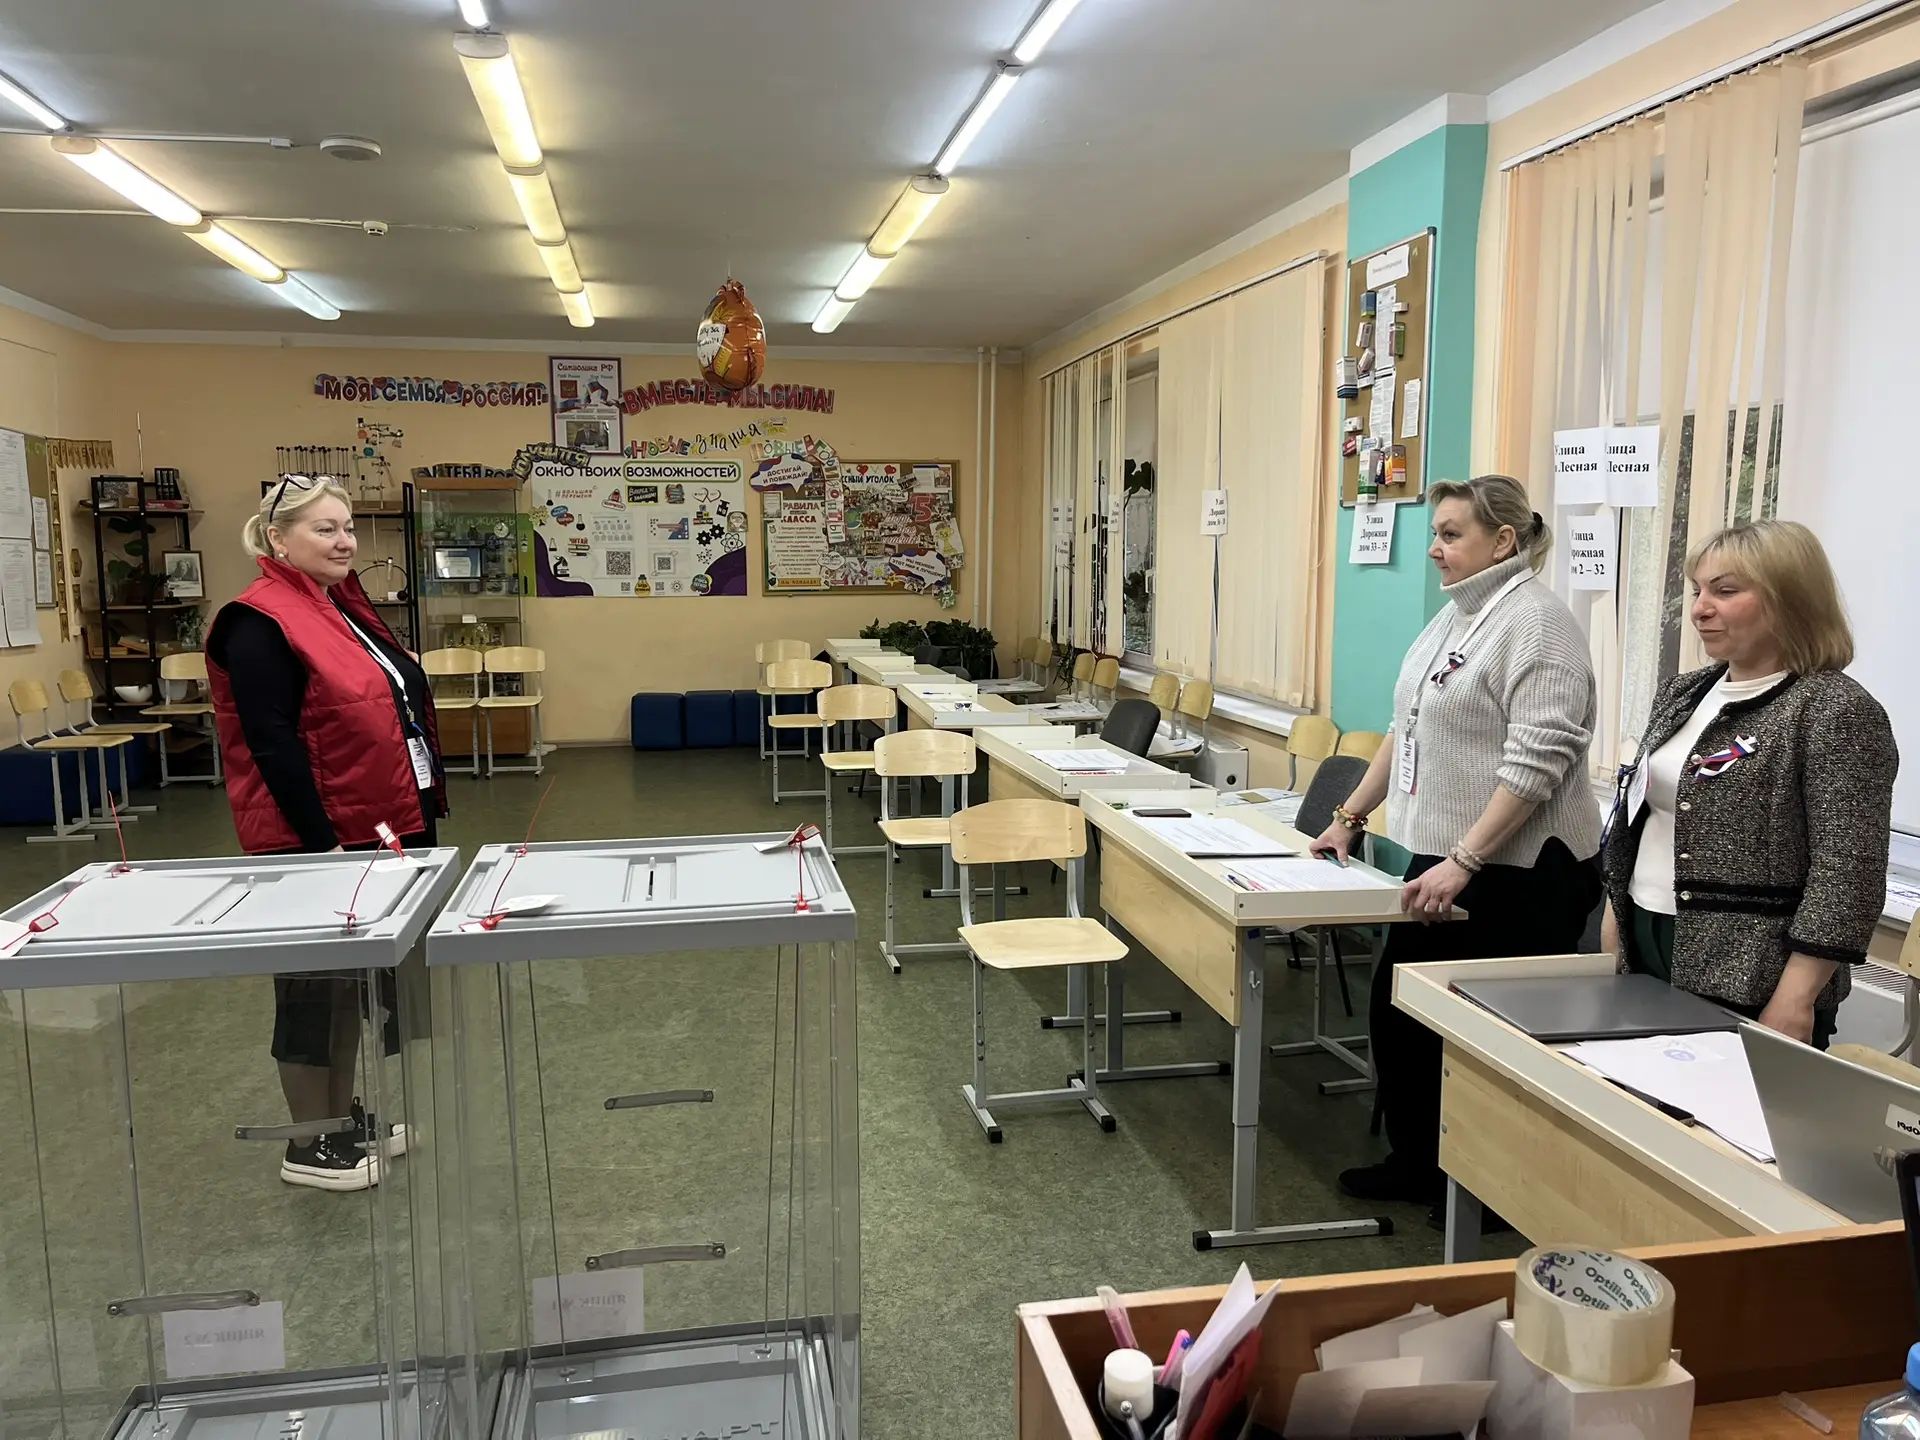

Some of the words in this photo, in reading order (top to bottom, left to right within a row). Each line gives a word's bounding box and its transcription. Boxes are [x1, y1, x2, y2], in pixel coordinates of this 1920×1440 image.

[600, 363, 614, 372] РФ
[324, 379, 372, 401] МОЯ
[382, 382, 446, 403] СЕМЬЯ
[461, 386, 543, 408] РОССИЯ!
[623, 378, 718, 415] ВМЕСТЕ
[727, 383, 766, 408] МЫ
[769, 383, 836, 414] СИЛА!
[630, 434, 692, 459] НОВЫЕ
[534, 466, 575, 477] ОКНО
[579, 465, 622, 477] ТВОИХ
[626, 464, 737, 478] ВОЗМОЖНОСТЕЙ
[767, 465, 802, 477] ДОСТИГАЙ
[769, 472, 808, 484] ПОБЕЖДАЙ!
[866, 475, 895, 484] УГОЛОК
[782, 502, 820, 511] РАВИЛА
[1594, 563, 1605, 575] 32
[1585, 1266, 1635, 1308] Optiline
[1572, 1286, 1610, 1311] Optili
